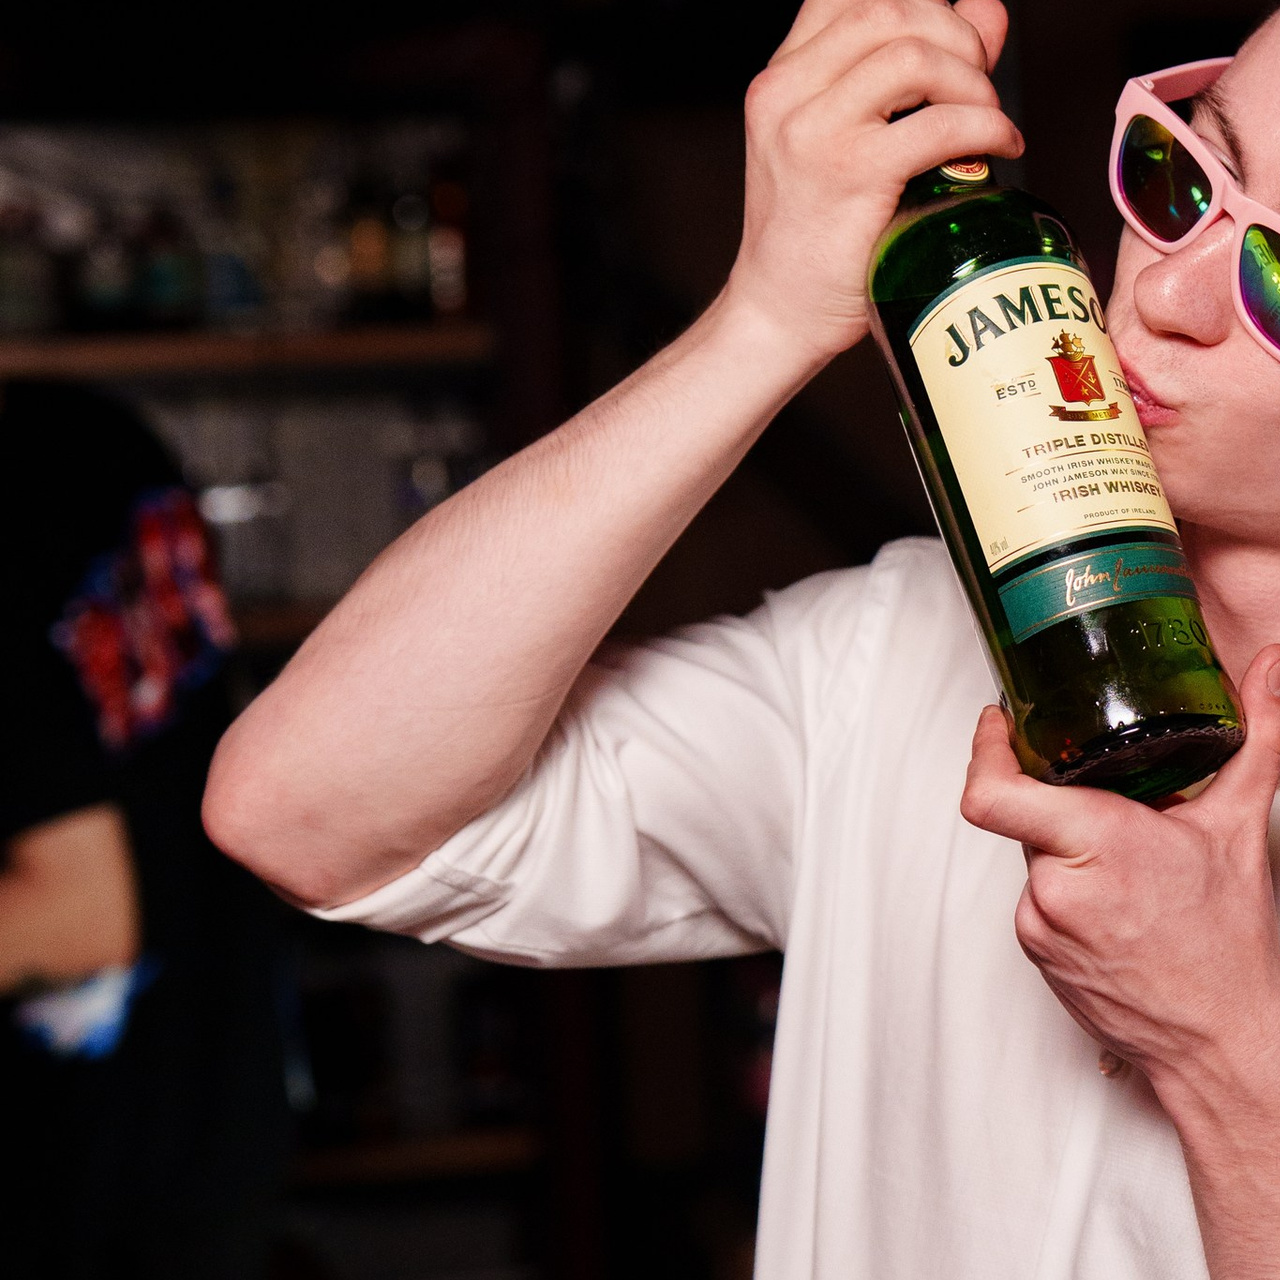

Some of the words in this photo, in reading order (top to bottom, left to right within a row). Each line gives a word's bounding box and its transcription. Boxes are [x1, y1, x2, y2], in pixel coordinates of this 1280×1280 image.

[945, 283, 1107, 367] JAMESO
[1022, 435, 1087, 459] TRIPLE
[1020, 465, 1065, 484] SMOOTH
[1067, 460, 1095, 470] IRISH
[1096, 457, 1136, 466] WHISKEY
[1032, 477, 1060, 492] JOHN
[1062, 468, 1109, 483] JAMESON
[1110, 468, 1129, 476] WAY
[1130, 469, 1150, 479] SINCE
[1052, 482, 1101, 503] IRISH
[1103, 480, 1162, 498] WHISKEY
[1083, 509, 1119, 520] PRODUCT
[1131, 507, 1157, 515] IRELAND
[1065, 564, 1111, 607] John
